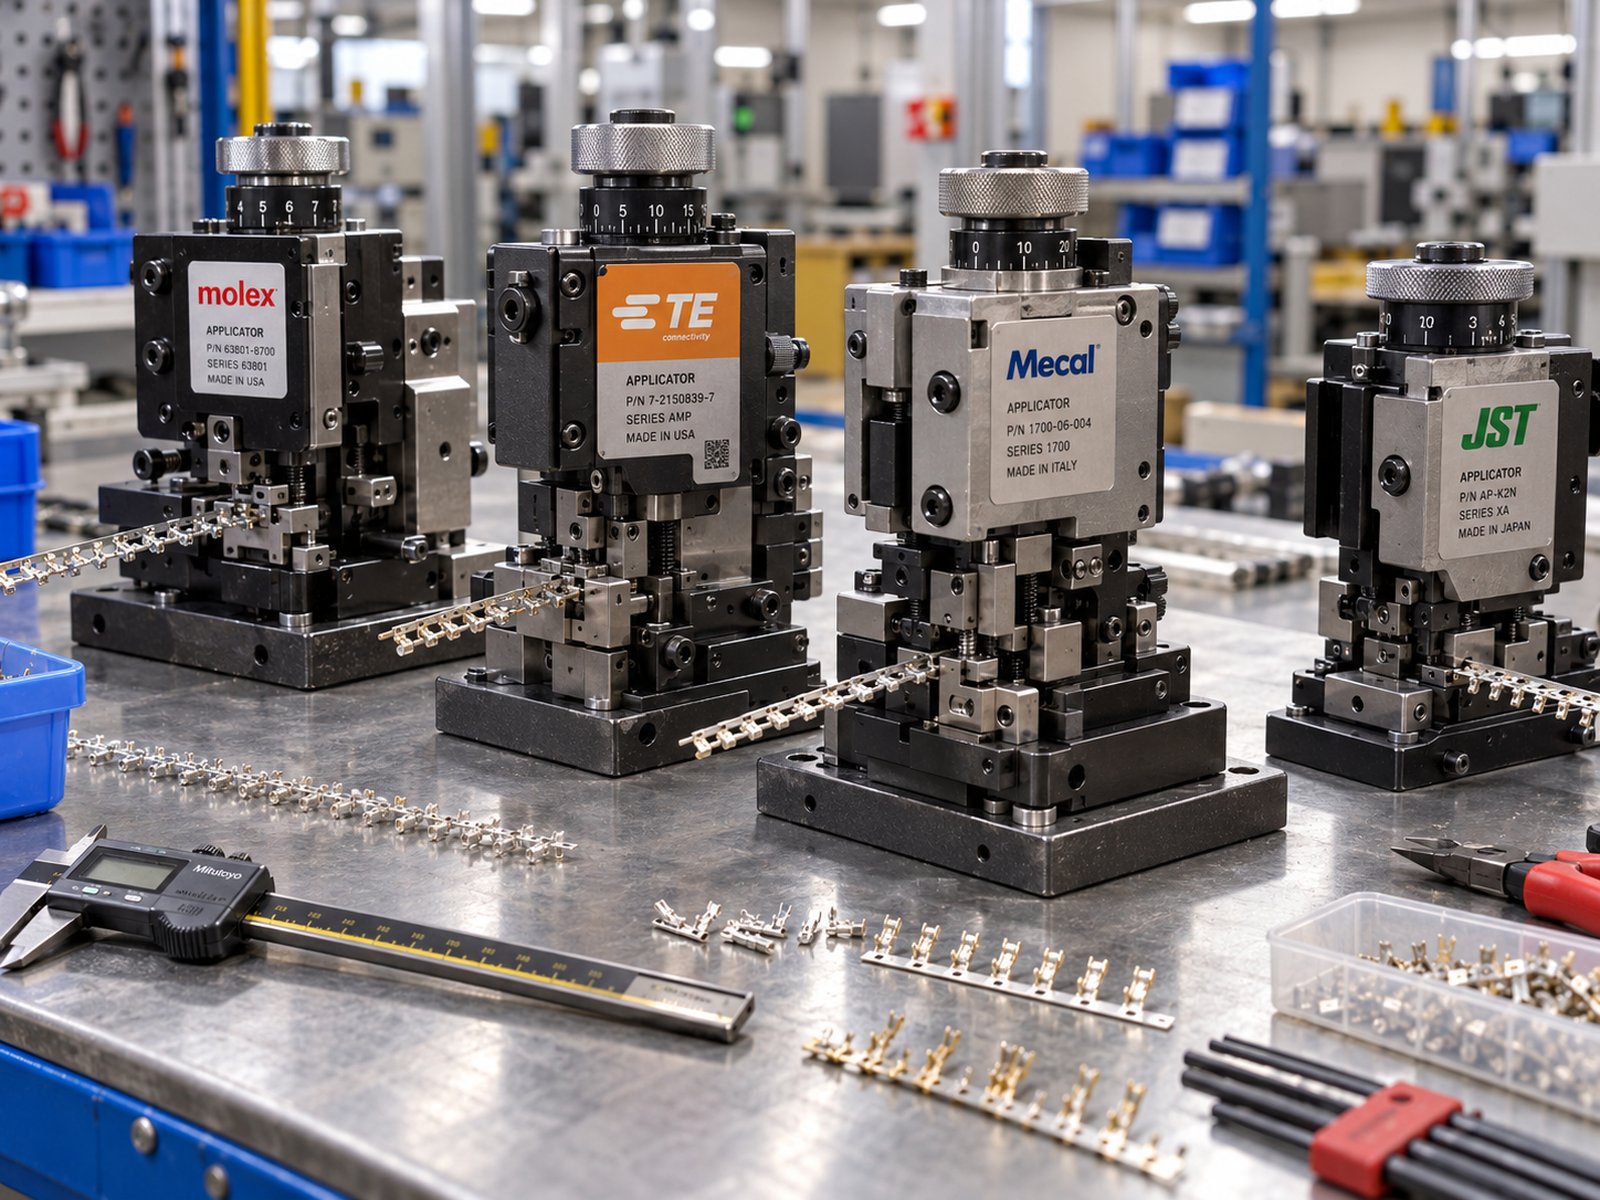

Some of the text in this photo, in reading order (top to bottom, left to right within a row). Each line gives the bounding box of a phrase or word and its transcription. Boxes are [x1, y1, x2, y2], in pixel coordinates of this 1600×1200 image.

[259, 200, 267, 213] 5
[285, 200, 294, 213] 6
[312, 200, 319, 212] 7
[593, 204, 600, 217] 0
[619, 204, 628, 217] 5
[648, 204, 664, 217] 10
[683, 204, 694, 217] 15
[972, 241, 980, 254] 0
[1017, 241, 1032, 254] 10
[1059, 240, 1070, 253] 20
[198, 280, 276, 307] molex
[666, 292, 719, 329] TE
[1419, 316, 1435, 329] 20
[1468, 316, 1478, 329] 3
[206, 325, 264, 338] APPLICATOR
[662, 333, 711, 341] connectivity
[206, 343, 276, 356] P/N 63801-8700
[207, 358, 267, 371] SERIES 63801
[1006, 344, 1095, 380] Mecal
[207, 374, 265, 386] MADE IN USA
[626, 372, 696, 386] APPLICATOR
[626, 392, 715, 407] P/N 7-2150839-7
[1007, 397, 1070, 414] APPLICATOR
[626, 411, 692, 425] SERIES AMP
[1007, 417, 1092, 437] P/N 1700-06-004
[1461, 403, 1538, 450] JST
[626, 429, 696, 443] MADE IN USA
[1006, 440, 1070, 458] SERIES 1700
[1007, 459, 1078, 478] MADE IN ITALY
[1460, 466, 1522, 483] APPLICATOR
[1460, 487, 1517, 502] P/N AP-K2N
[1459, 505, 1510, 520] SERIES XA
[1458, 521, 1531, 539] MADE IN JAPAN
[192, 864, 243, 880] Mitutoyo
